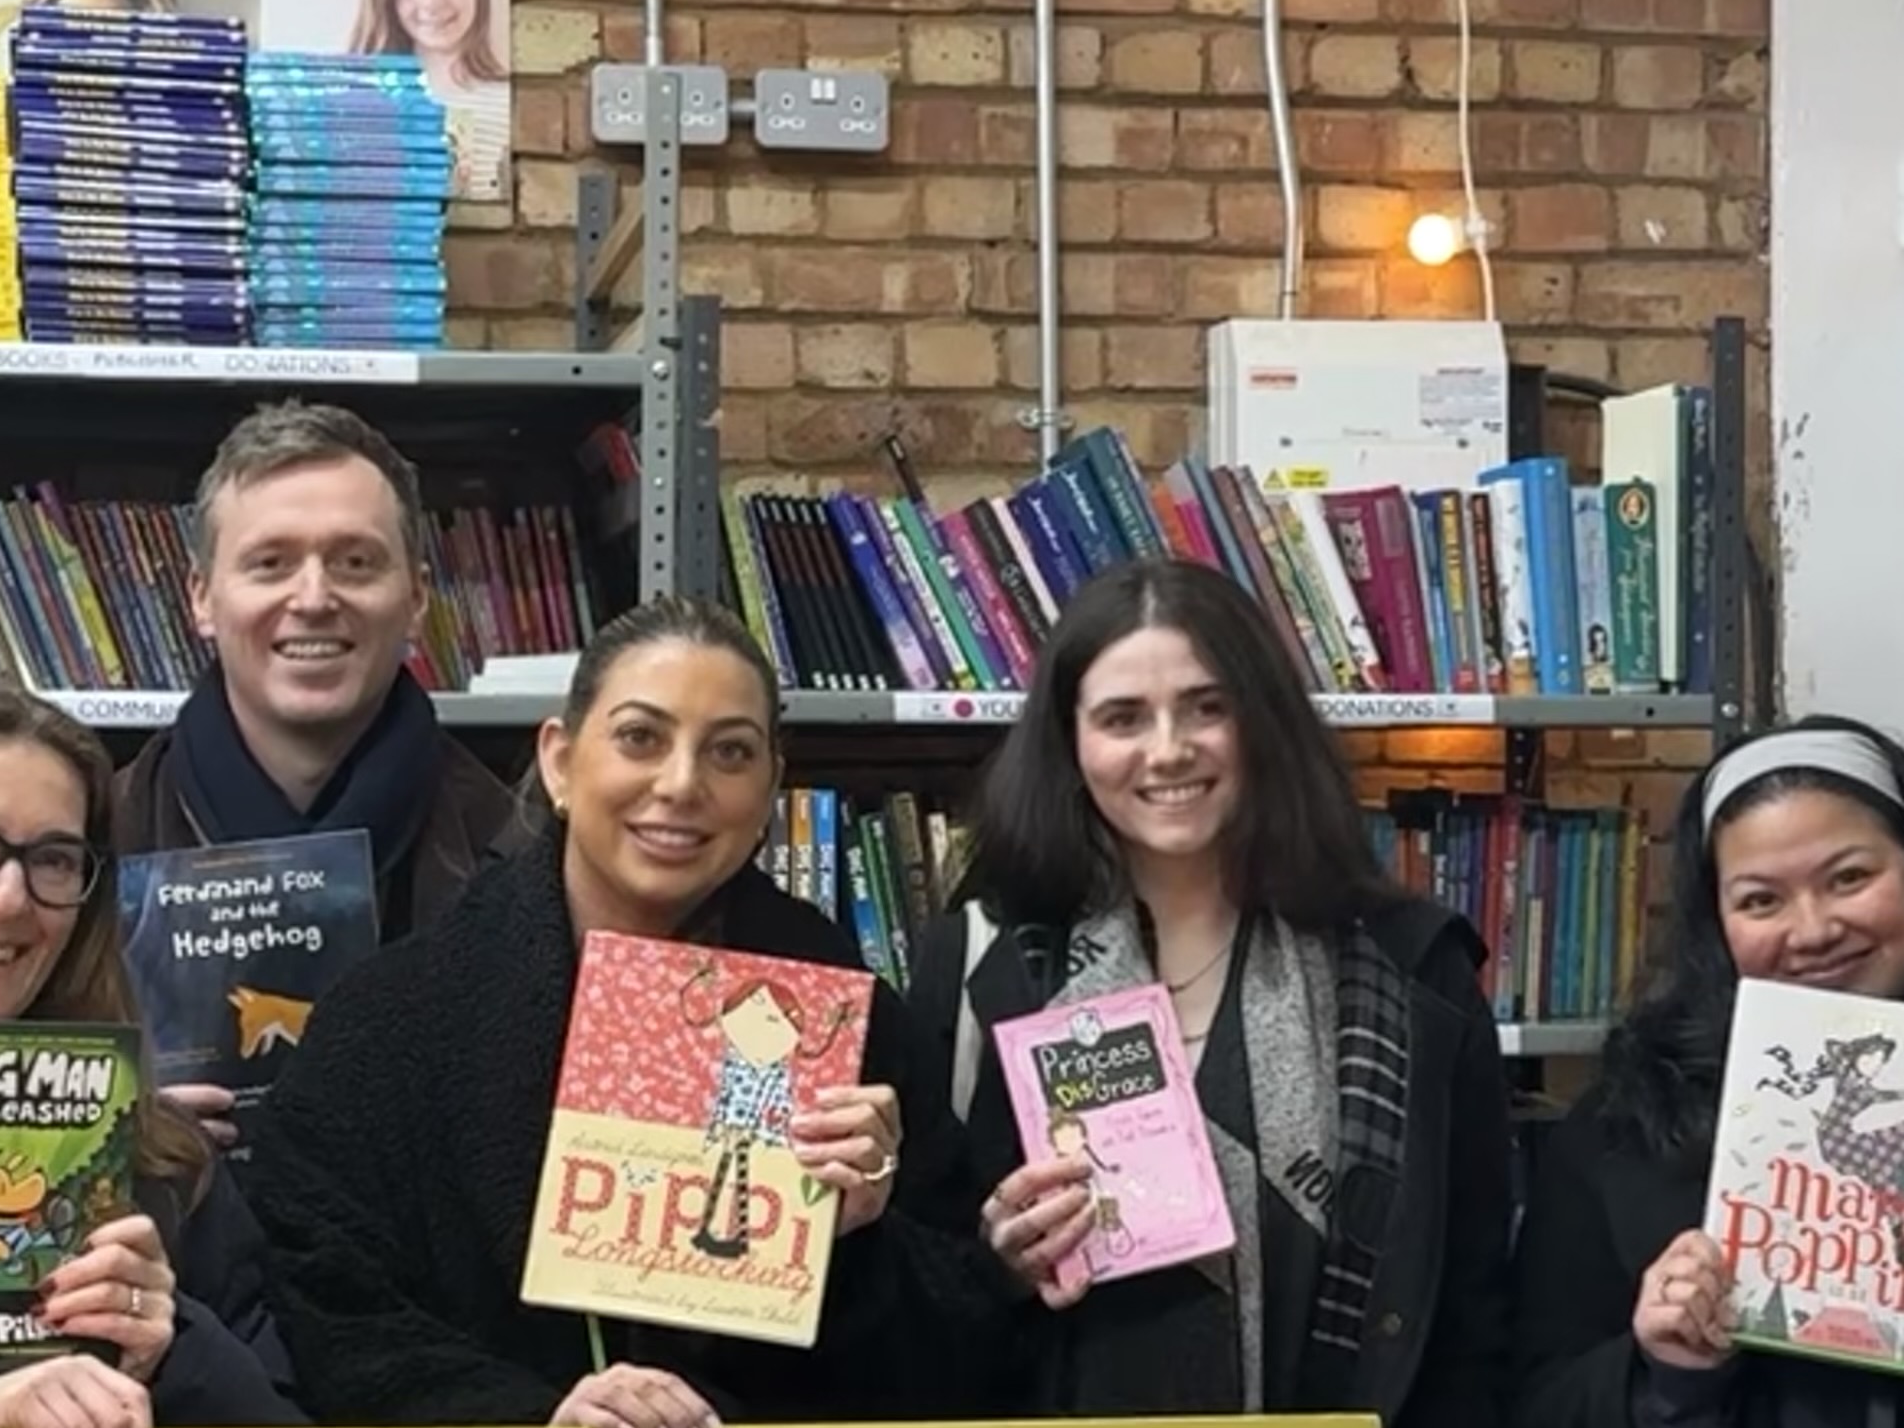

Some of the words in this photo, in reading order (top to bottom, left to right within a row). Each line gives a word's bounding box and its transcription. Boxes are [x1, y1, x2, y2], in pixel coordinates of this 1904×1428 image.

[1320, 700, 1434, 718] DONATIONS
[157, 874, 274, 907] Ferdinand
[209, 904, 244, 923] and
[172, 923, 322, 960] Hedgehog
[26, 1049, 114, 1103] MAN
[1038, 1037, 1152, 1082] Princess
[548, 1155, 813, 1273] Pippi
